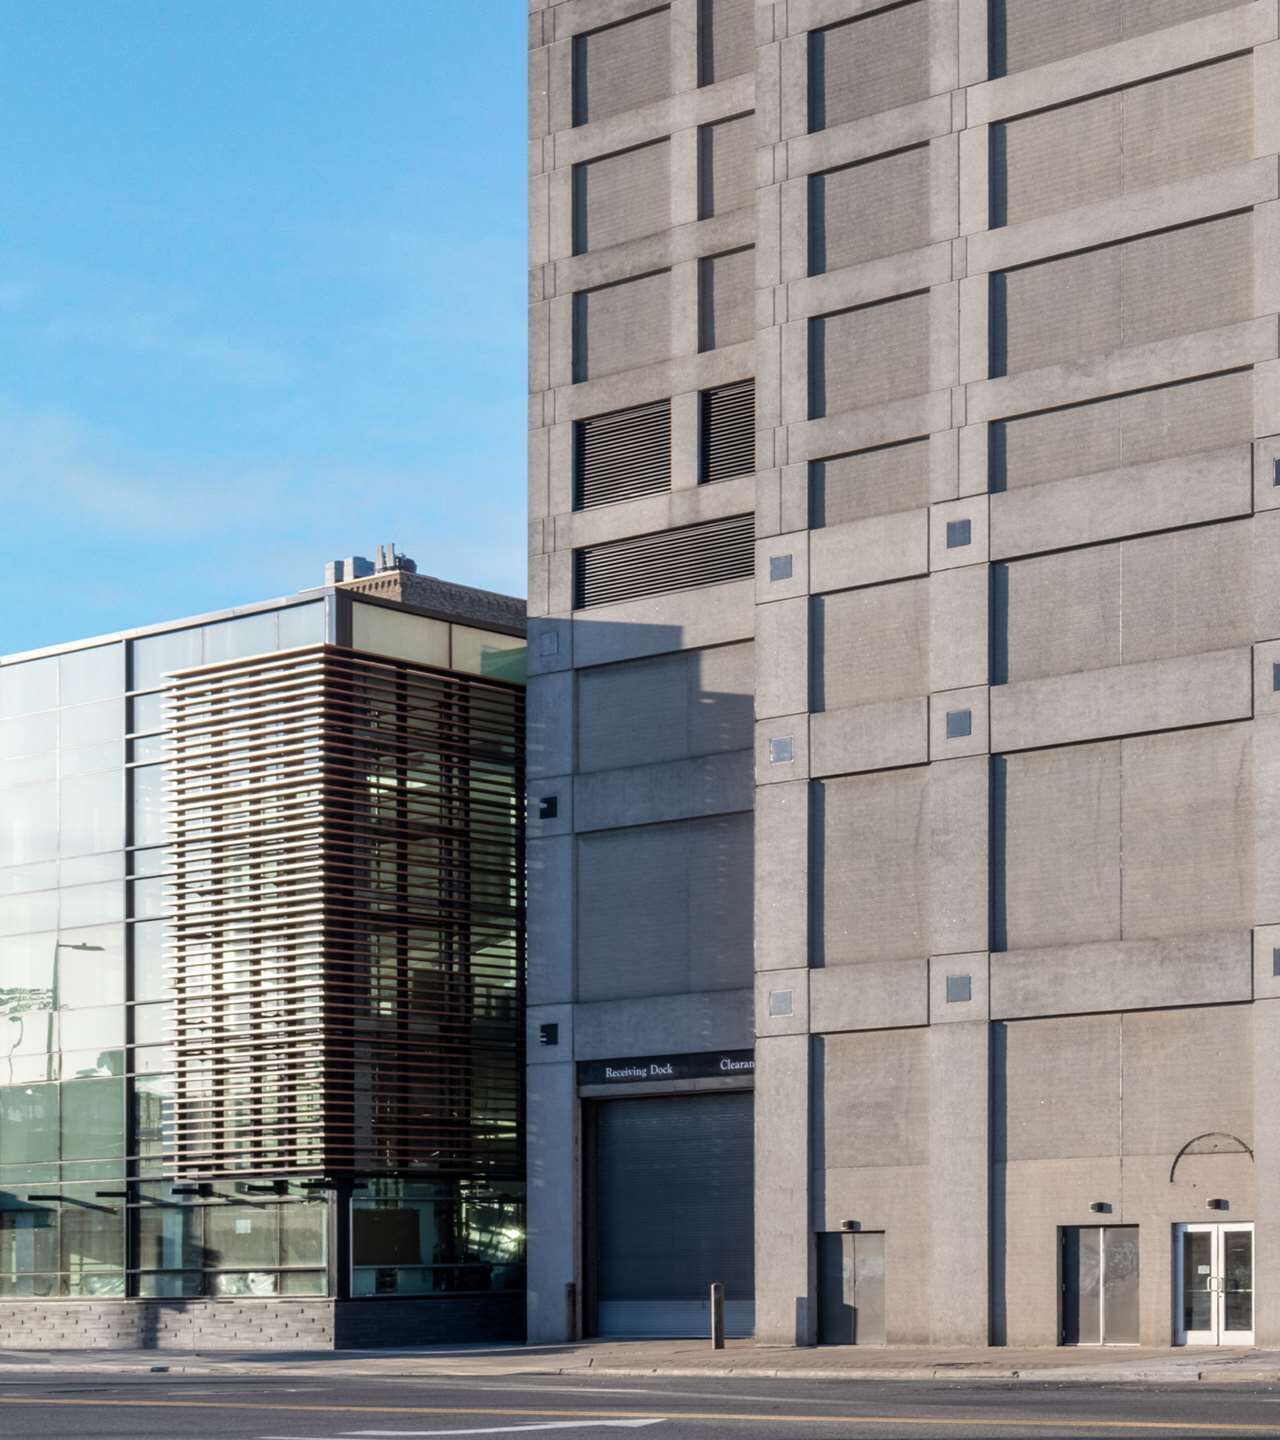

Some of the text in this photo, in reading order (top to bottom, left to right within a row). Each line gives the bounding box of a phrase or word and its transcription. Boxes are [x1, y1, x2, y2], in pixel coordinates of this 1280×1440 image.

[605, 1063, 673, 1078] Receiving Dock
[720, 1058, 756, 1071] Clearan
